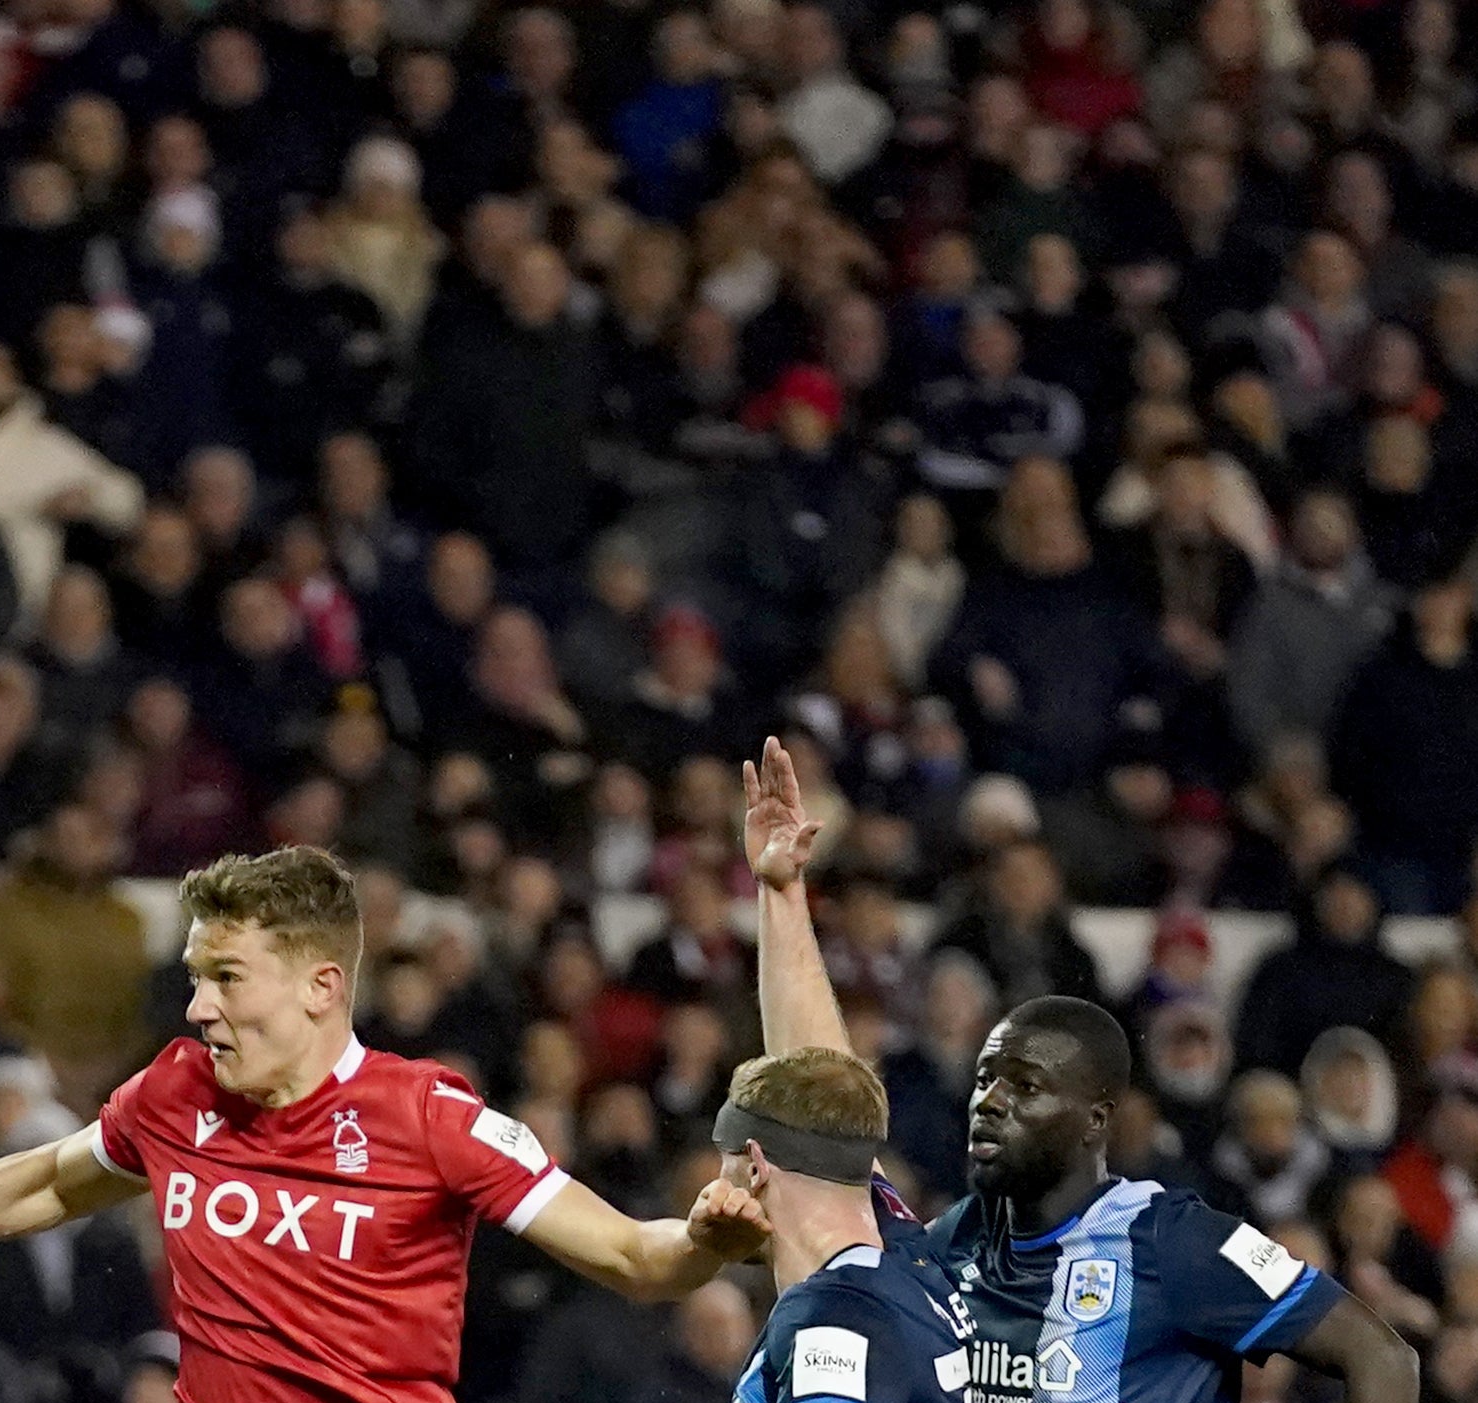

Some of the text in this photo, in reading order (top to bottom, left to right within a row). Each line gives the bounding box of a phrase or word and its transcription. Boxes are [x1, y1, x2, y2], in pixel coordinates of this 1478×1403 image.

[163, 1171, 375, 1260] BOXT
[804, 1352, 856, 1373] SKINNY
[971, 1339, 1034, 1390] ilita
